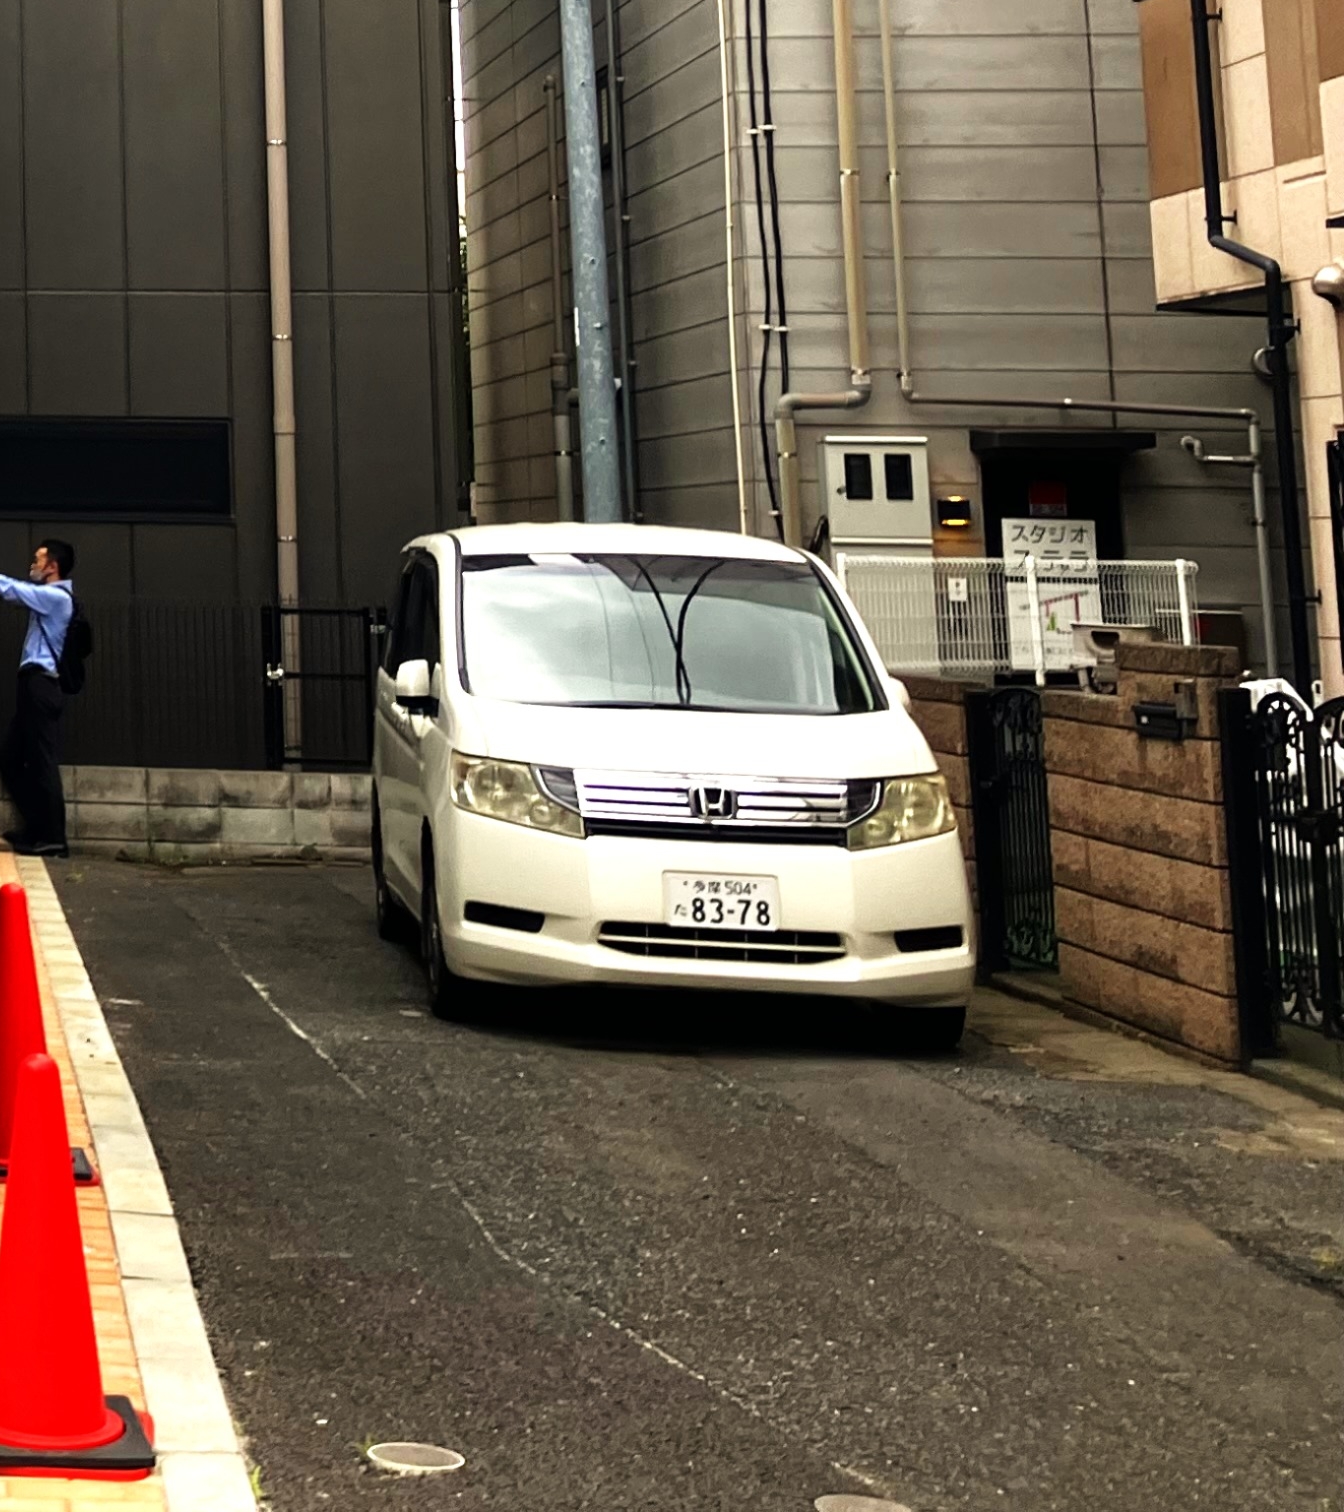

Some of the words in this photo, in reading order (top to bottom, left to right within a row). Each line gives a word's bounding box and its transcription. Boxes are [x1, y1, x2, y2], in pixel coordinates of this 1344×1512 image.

[1011, 525, 1088, 544] スタジオ
[724, 880, 752, 895] 504
[692, 897, 771, 927] 83-78
